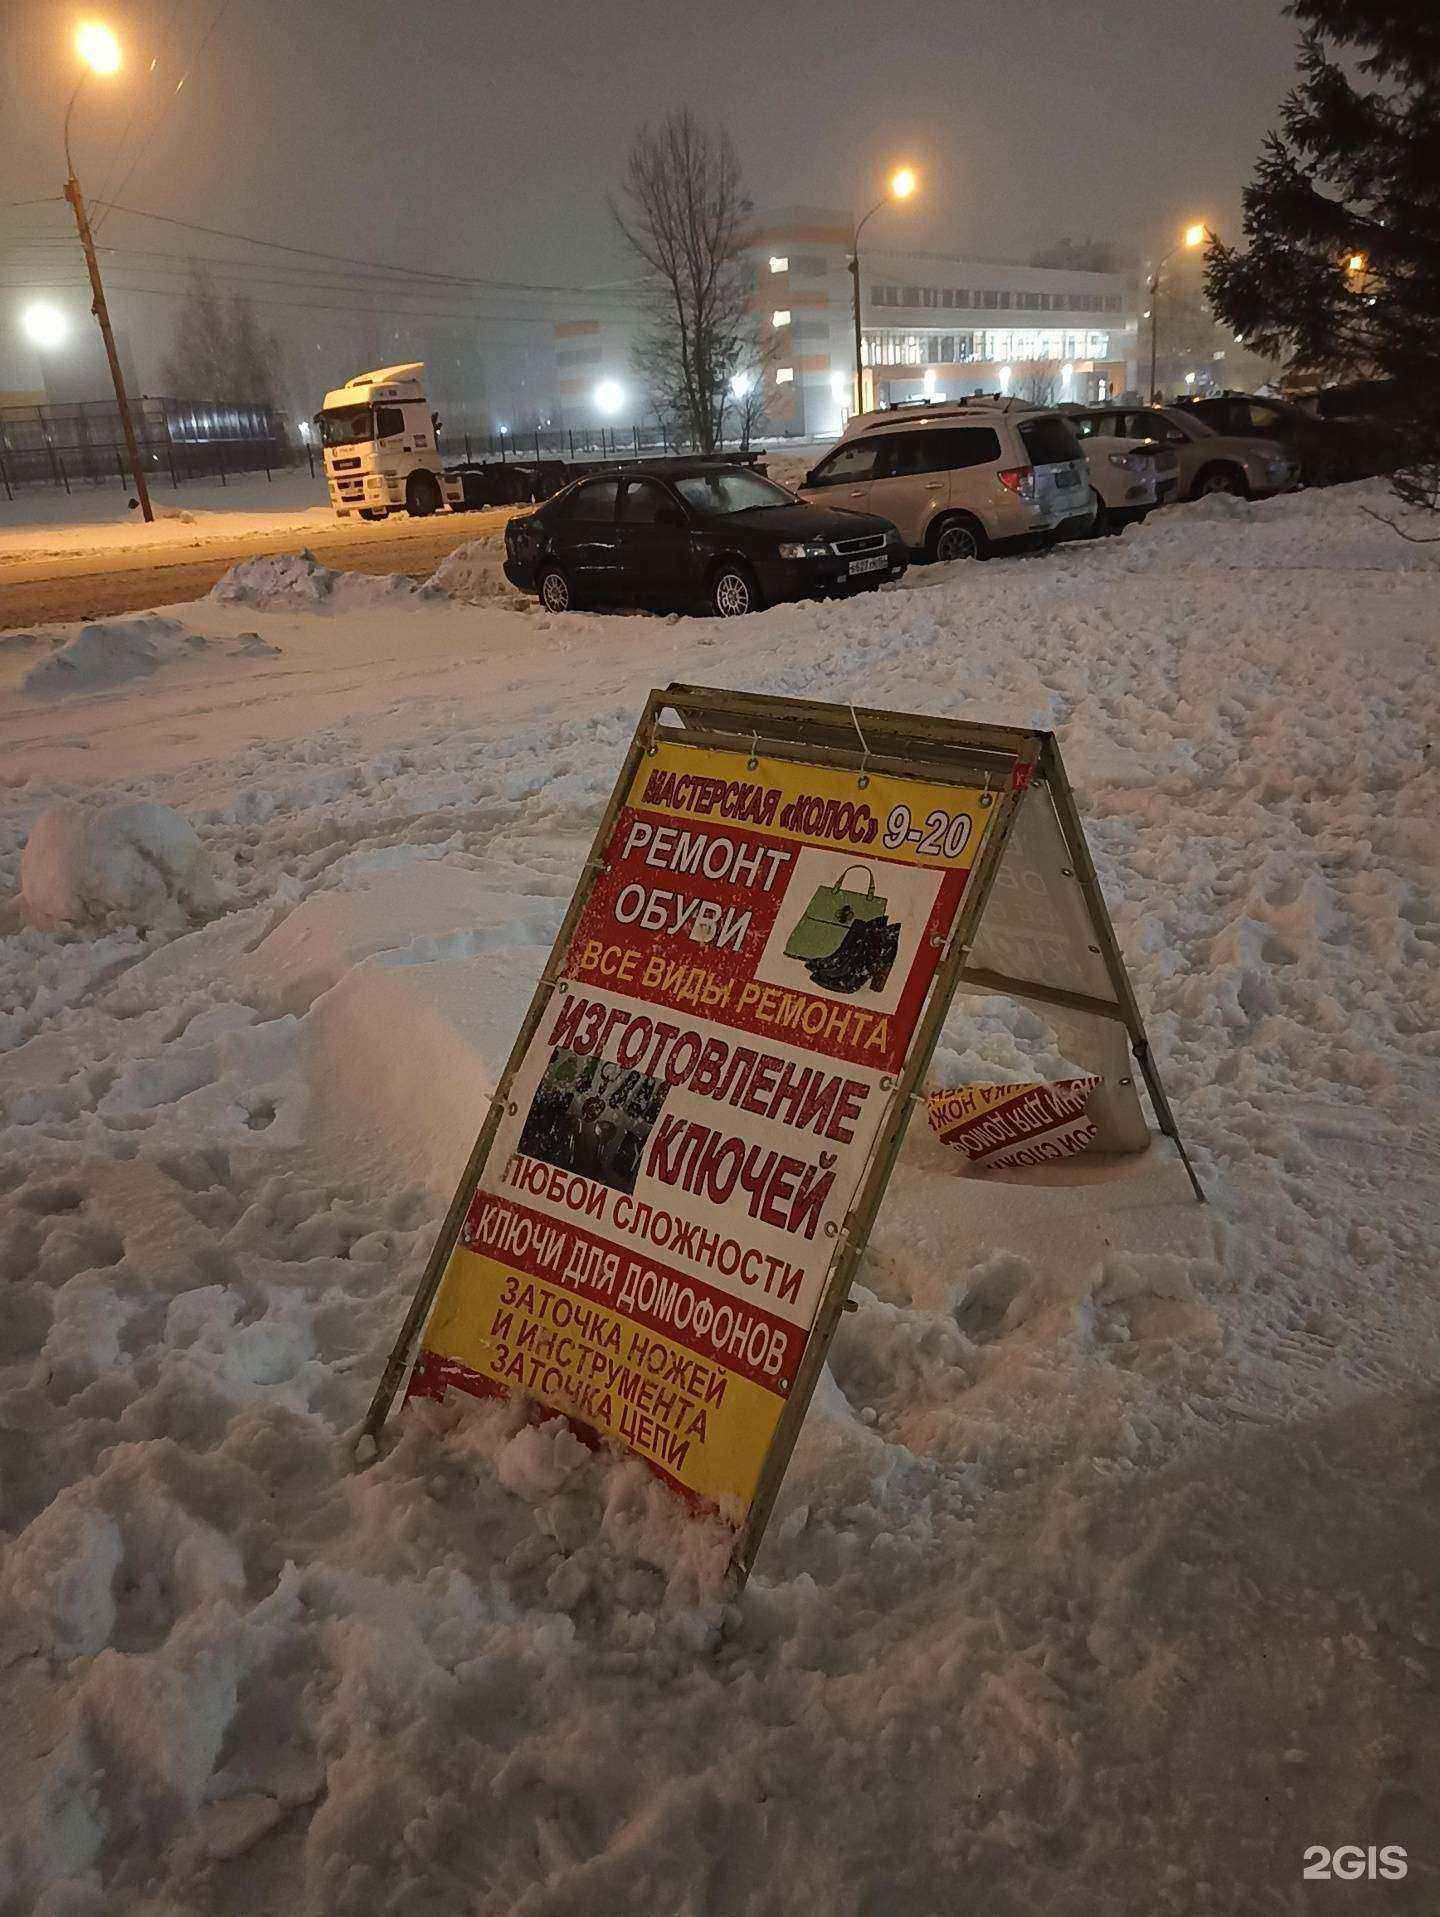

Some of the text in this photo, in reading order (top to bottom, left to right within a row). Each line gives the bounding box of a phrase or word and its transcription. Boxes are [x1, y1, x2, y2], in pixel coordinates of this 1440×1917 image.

[621, 821, 792, 892] РЕМОНТ
[642, 769, 782, 826] МАСТЕРСКАЯ
[883, 805, 972, 858] 9-20
[614, 884, 754, 952] ОБУВИ
[580, 940, 891, 1053] ВСЕ ВИДЫ РЕМОНТА
[548, 994, 870, 1144] ИЗГОТОВЛЕНИЕ
[646, 1114, 837, 1240] КЛЮЧЕЙ
[475, 1203, 788, 1376] КЛЮЧИ ДЛЯ ДОМОФОНОВ
[612, 1196, 805, 1305] СЛОЖНОСТИ
[490, 1309, 707, 1444] И ИНСТРУМЕНТА
[500, 1276, 728, 1409] ЗАТОЧКА НОЖЕЙ
[490, 1344, 691, 1471] ЗАТОЧКА ЦЕПИ
